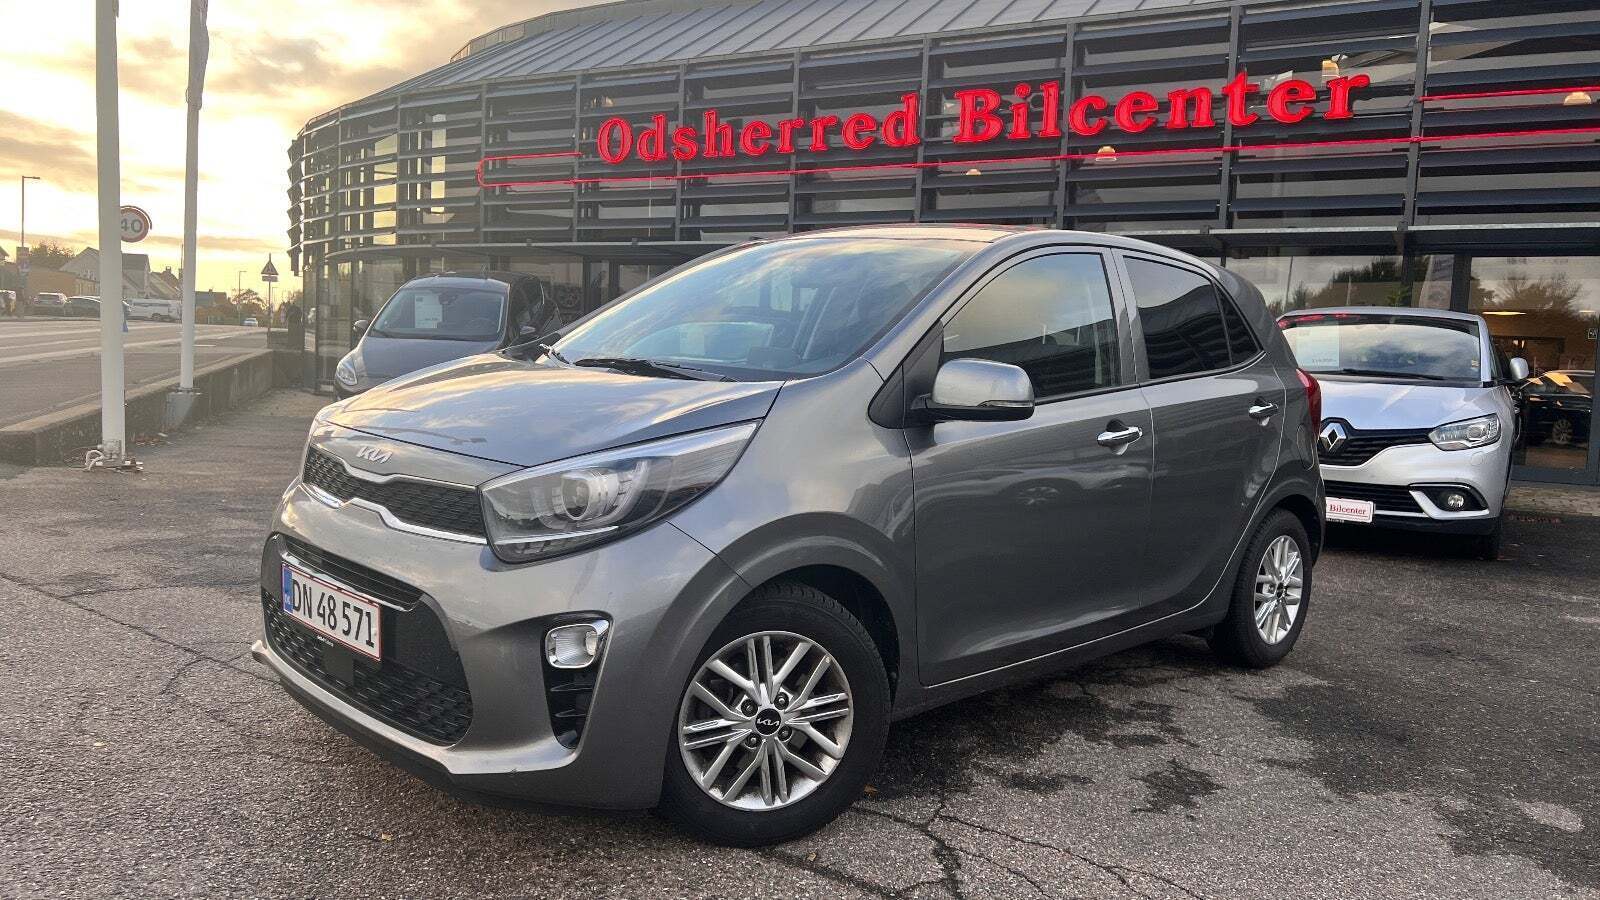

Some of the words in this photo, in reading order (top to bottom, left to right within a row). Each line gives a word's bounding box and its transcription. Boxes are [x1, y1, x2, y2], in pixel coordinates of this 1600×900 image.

[596, 92, 921, 165] Odsherred
[951, 71, 1371, 144] Bilcenter
[121, 219, 142, 232] 40
[1329, 504, 1367, 515] Bilcenter
[293, 579, 312, 619] DN
[317, 592, 337, 630] 48
[342, 602, 375, 648] 571
